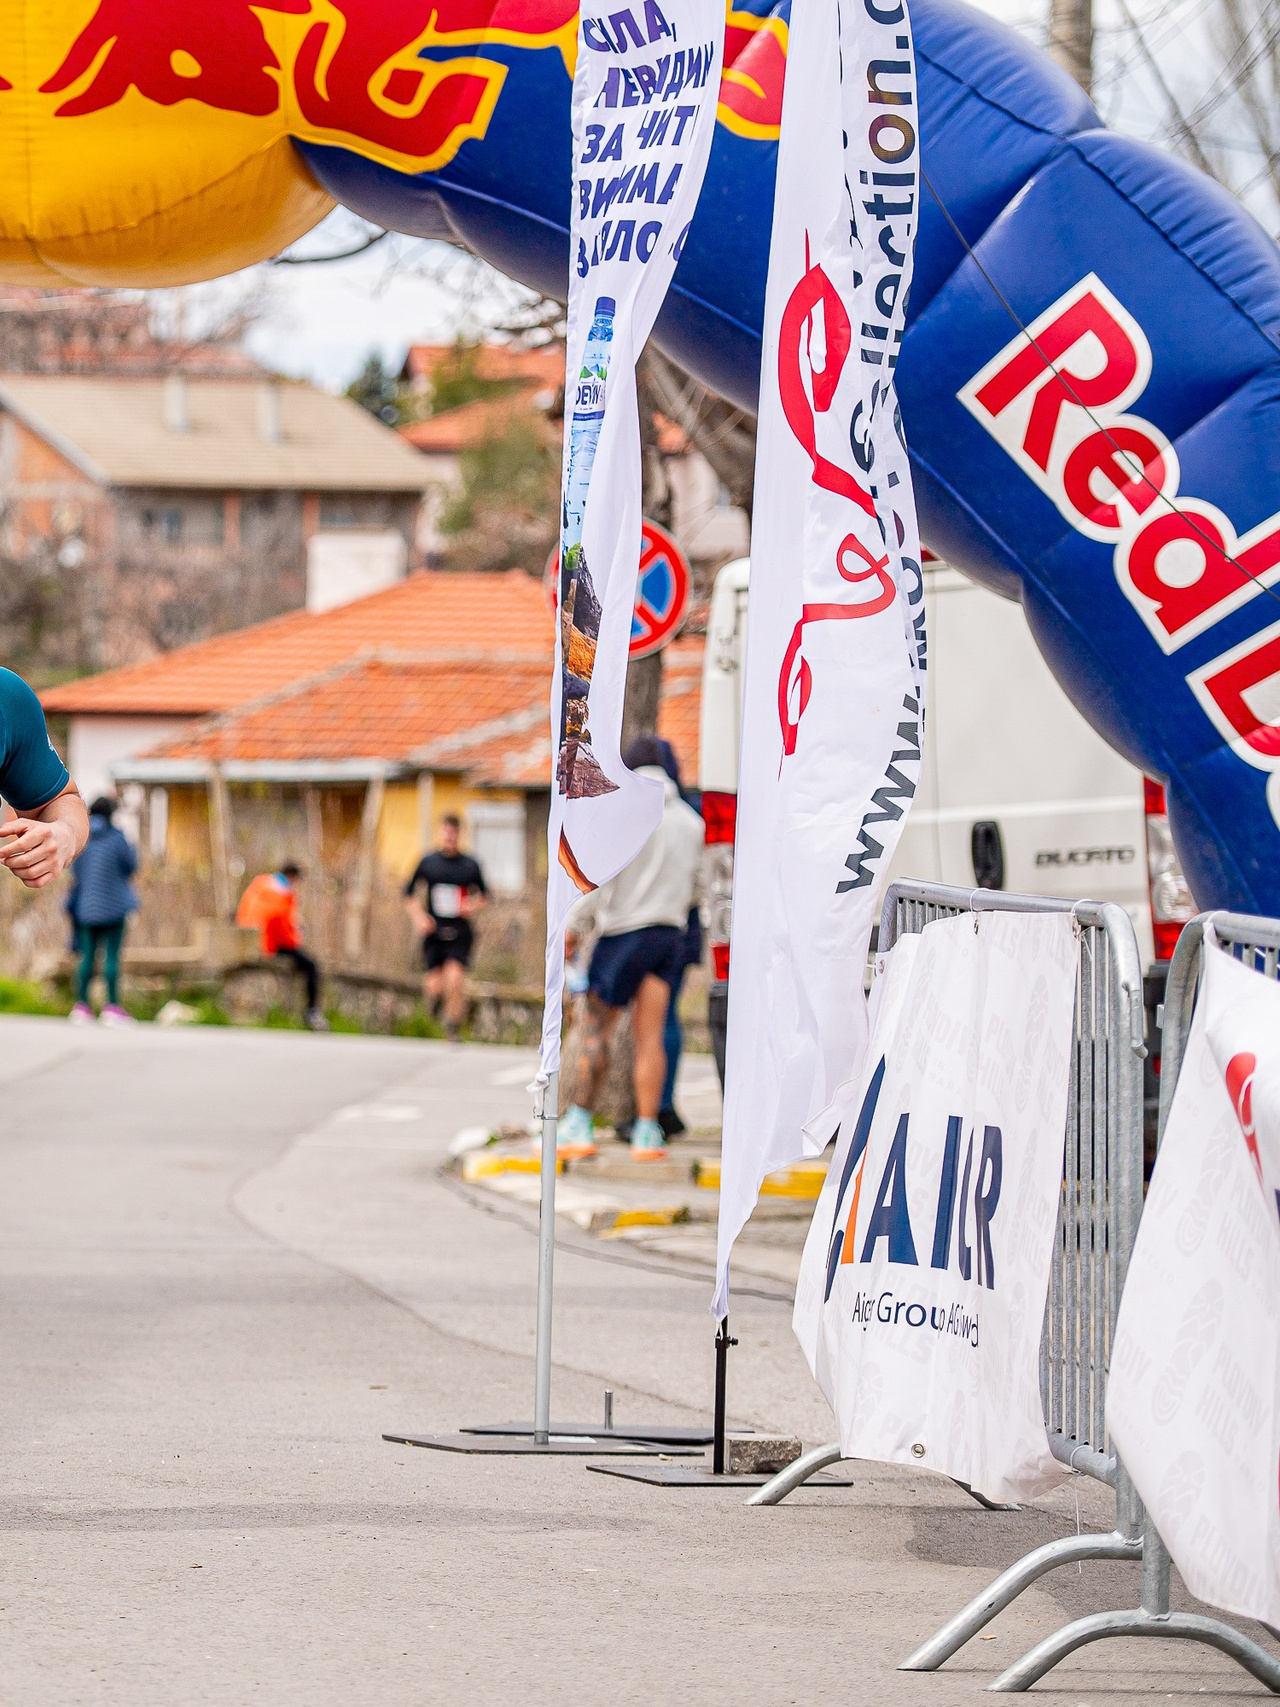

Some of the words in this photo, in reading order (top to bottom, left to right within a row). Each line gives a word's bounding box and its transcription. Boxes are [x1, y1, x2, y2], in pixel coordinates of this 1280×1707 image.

[580, 123, 625, 164] ЗА
[637, 104, 701, 150] ЧИТ
[972, 288, 1280, 638] Red
[1035, 847, 1137, 867] DUCATO
[877, 1291, 946, 1341] Group
